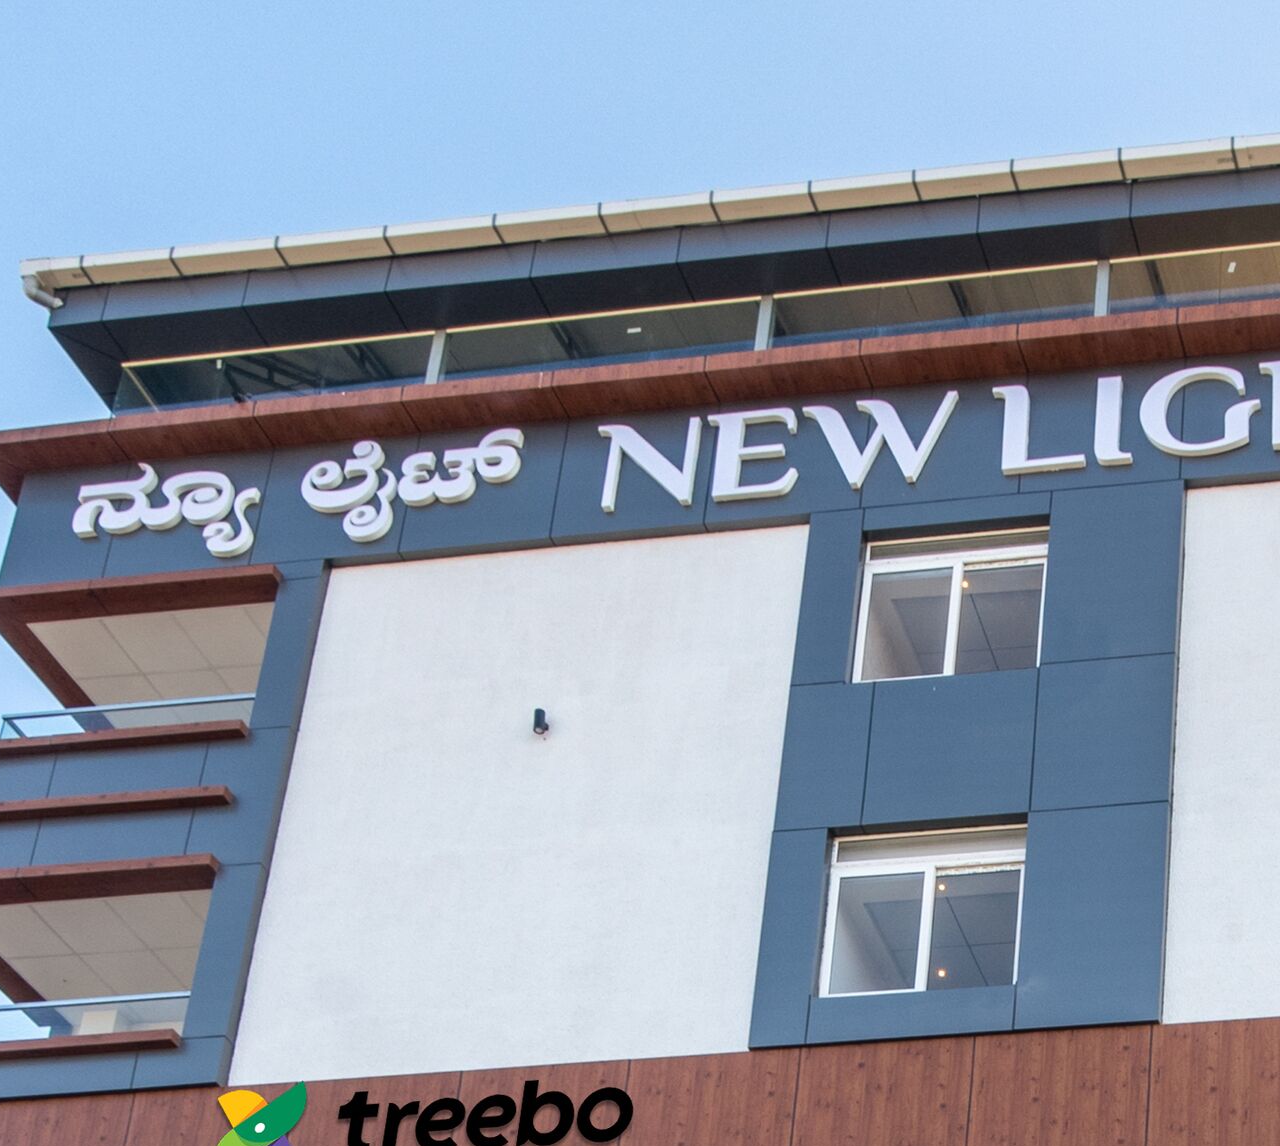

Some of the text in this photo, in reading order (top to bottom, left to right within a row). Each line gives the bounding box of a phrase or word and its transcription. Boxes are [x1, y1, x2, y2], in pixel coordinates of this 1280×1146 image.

[72, 428, 524, 558] ನ್ಯೂ ಲೈಟ್
[597, 389, 958, 513] NEW
